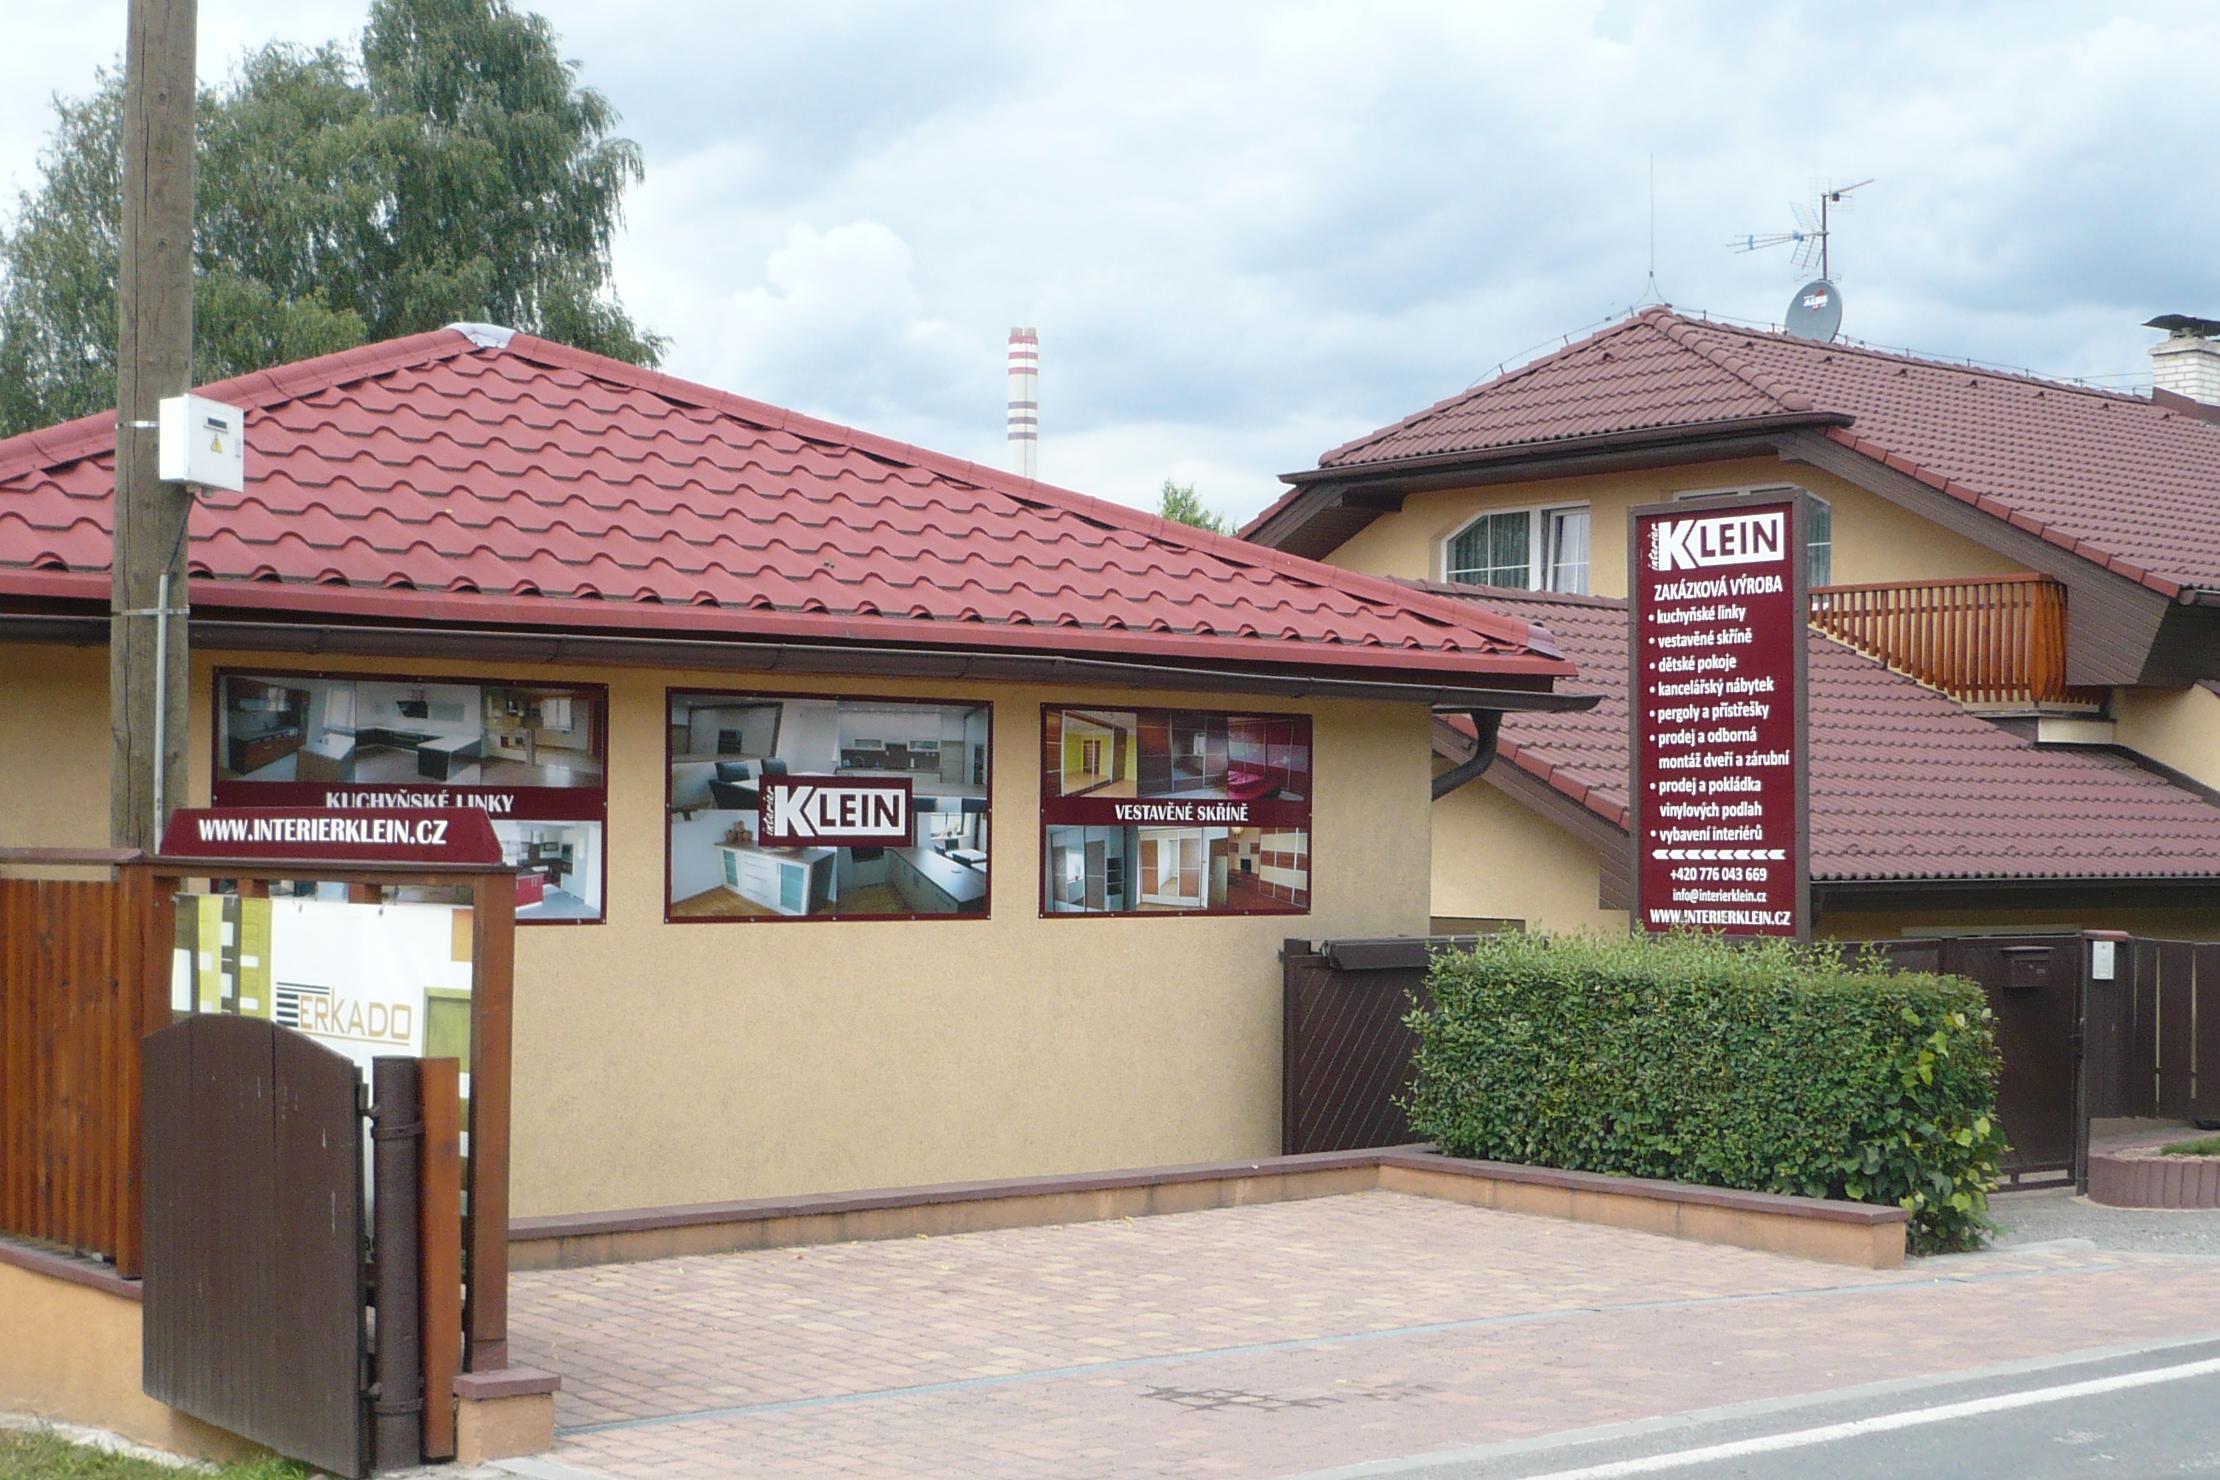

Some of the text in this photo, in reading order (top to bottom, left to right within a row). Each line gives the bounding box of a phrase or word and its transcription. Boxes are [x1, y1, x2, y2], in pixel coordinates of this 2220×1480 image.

[1658, 519, 1778, 572] KLEIN
[1654, 573, 1783, 601] ZAKÁZKOVÁ VÝROBA
[1657, 604, 1746, 625] kuchyňské linky
[1657, 627, 1752, 648] vestavěné skříně
[1658, 653, 1737, 673] dětské pokoje
[1658, 676, 1774, 697] kancelářský nábytek
[1658, 701, 1769, 724] pergoly a přístřešky
[1658, 726, 1757, 748] prodej a odborná
[1659, 749, 1790, 769] montáž dveří a zárubní
[1659, 776, 1761, 796] prodej a pokládka
[326, 788, 450, 808] KUCHYŇSKÉ
[774, 785, 900, 837] KLEIN
[1115, 801, 1249, 821] VESTAVĚNÉ SKŘÍNĚ
[1660, 801, 1762, 820] vinylových podlah
[199, 819, 448, 845] WWW.INTERIERKLEIN.CZ
[1659, 824, 1763, 845] vybavení interiérů
[1670, 867, 1767, 881] +420 776 043 669
[1672, 888, 1767, 903] info@interierklein.cz
